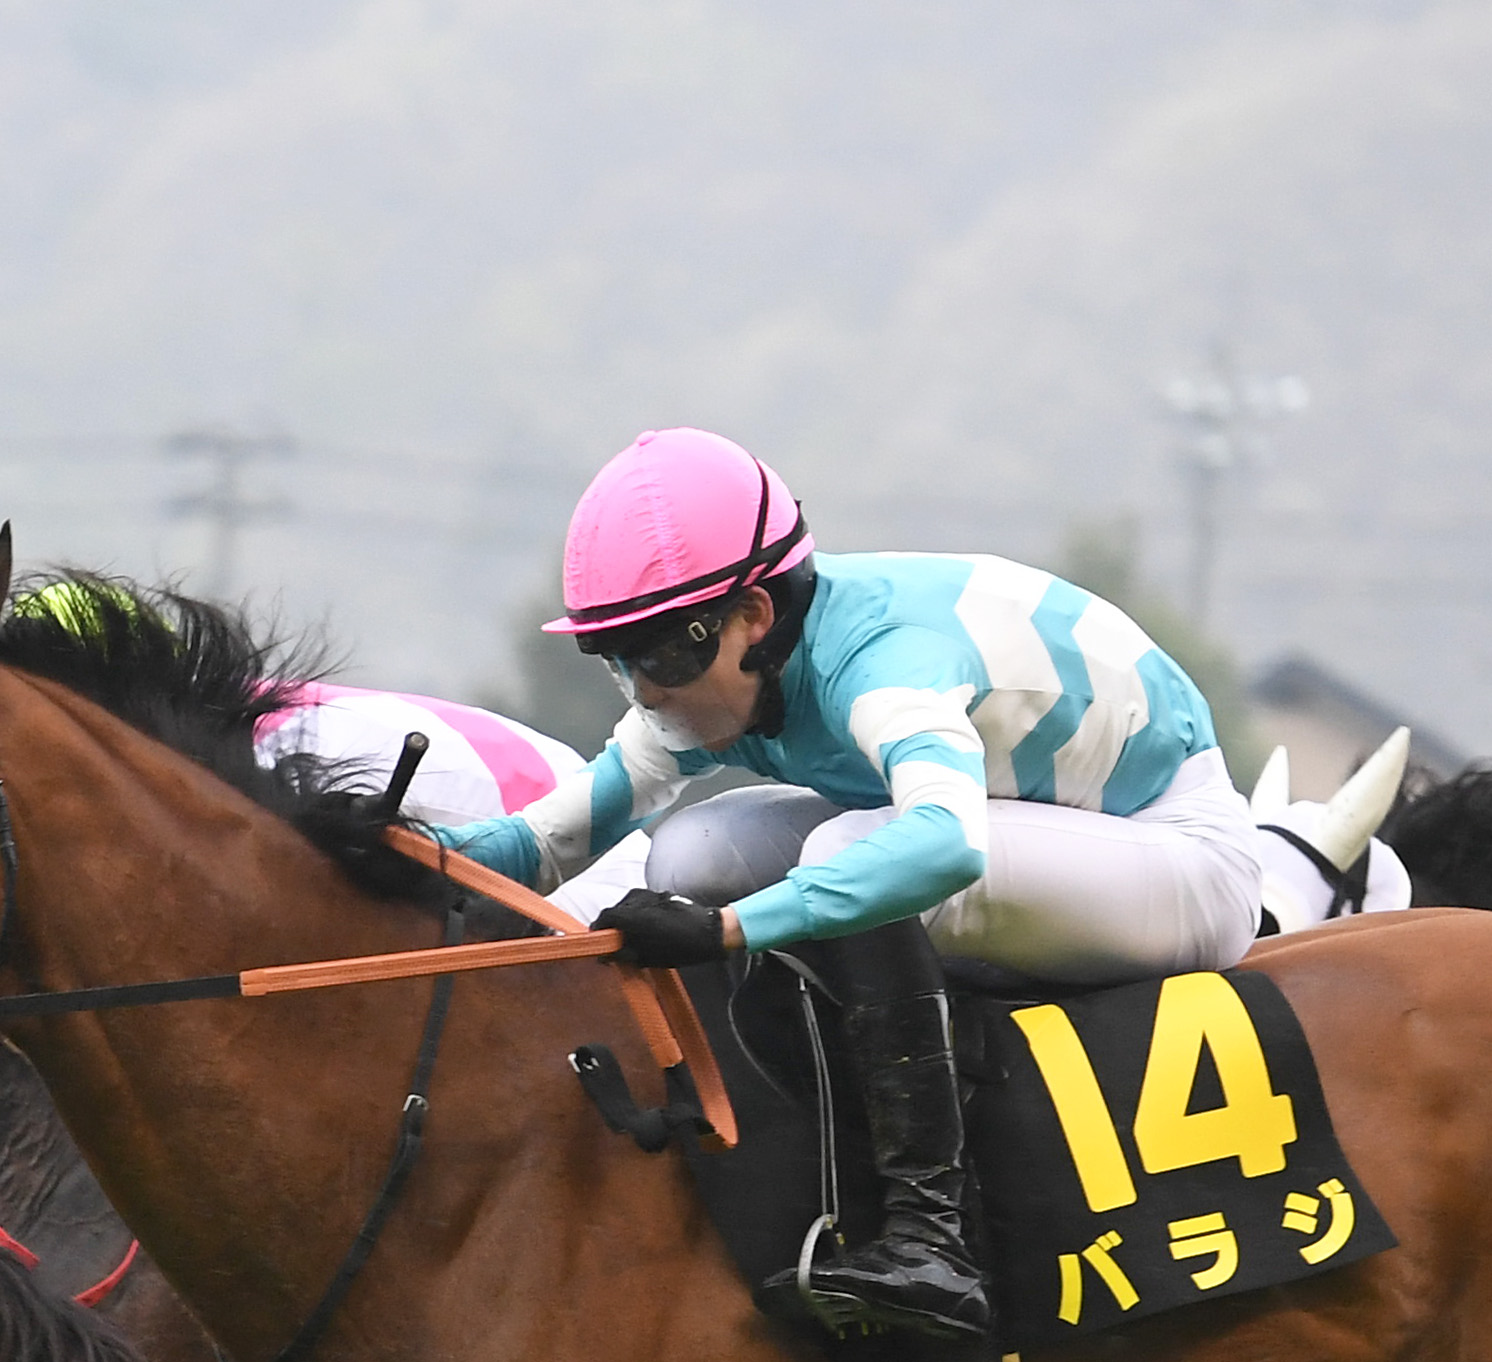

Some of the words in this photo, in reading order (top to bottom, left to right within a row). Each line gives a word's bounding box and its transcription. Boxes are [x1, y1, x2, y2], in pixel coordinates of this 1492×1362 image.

[1011, 972, 1297, 1212] 14
[1059, 1179, 1354, 1324] バラジ
